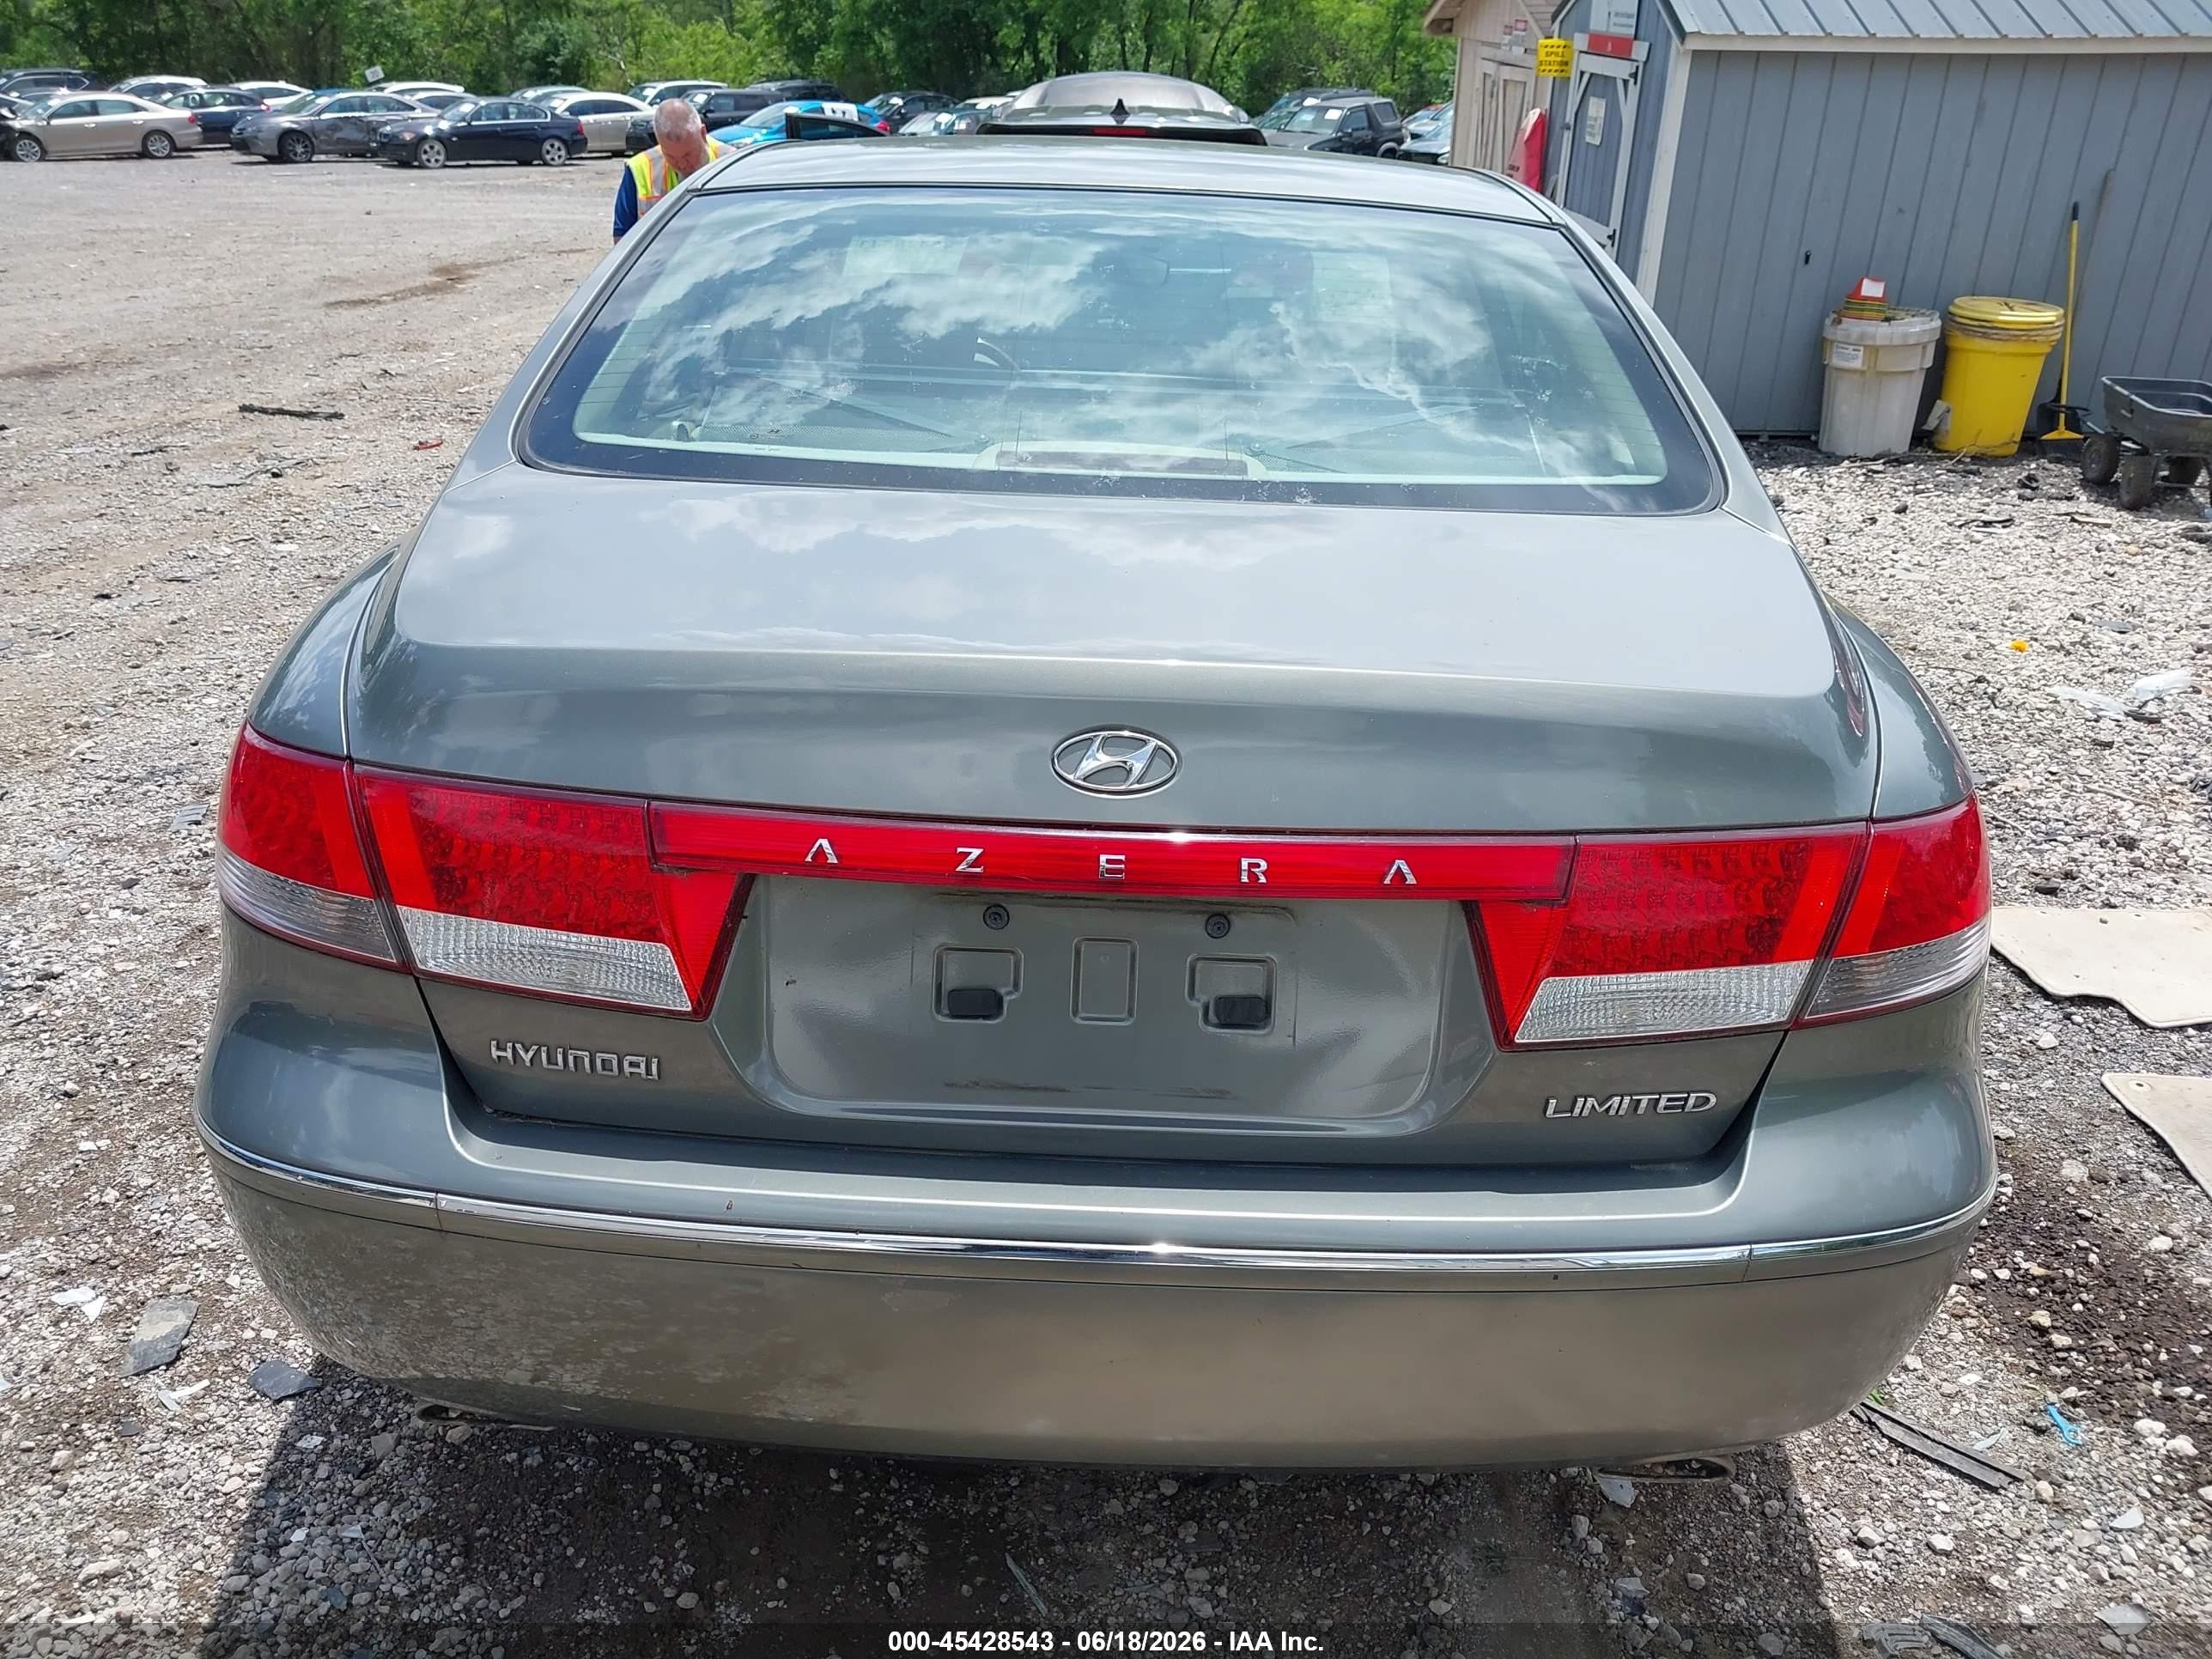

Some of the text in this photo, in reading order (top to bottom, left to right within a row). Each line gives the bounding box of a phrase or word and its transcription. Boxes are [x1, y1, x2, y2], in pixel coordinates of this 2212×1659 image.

[805, 837, 1417, 884] AZERA
[489, 1039, 660, 1081] HYUNDAI
[1545, 1091, 1717, 1119] LIMITED
